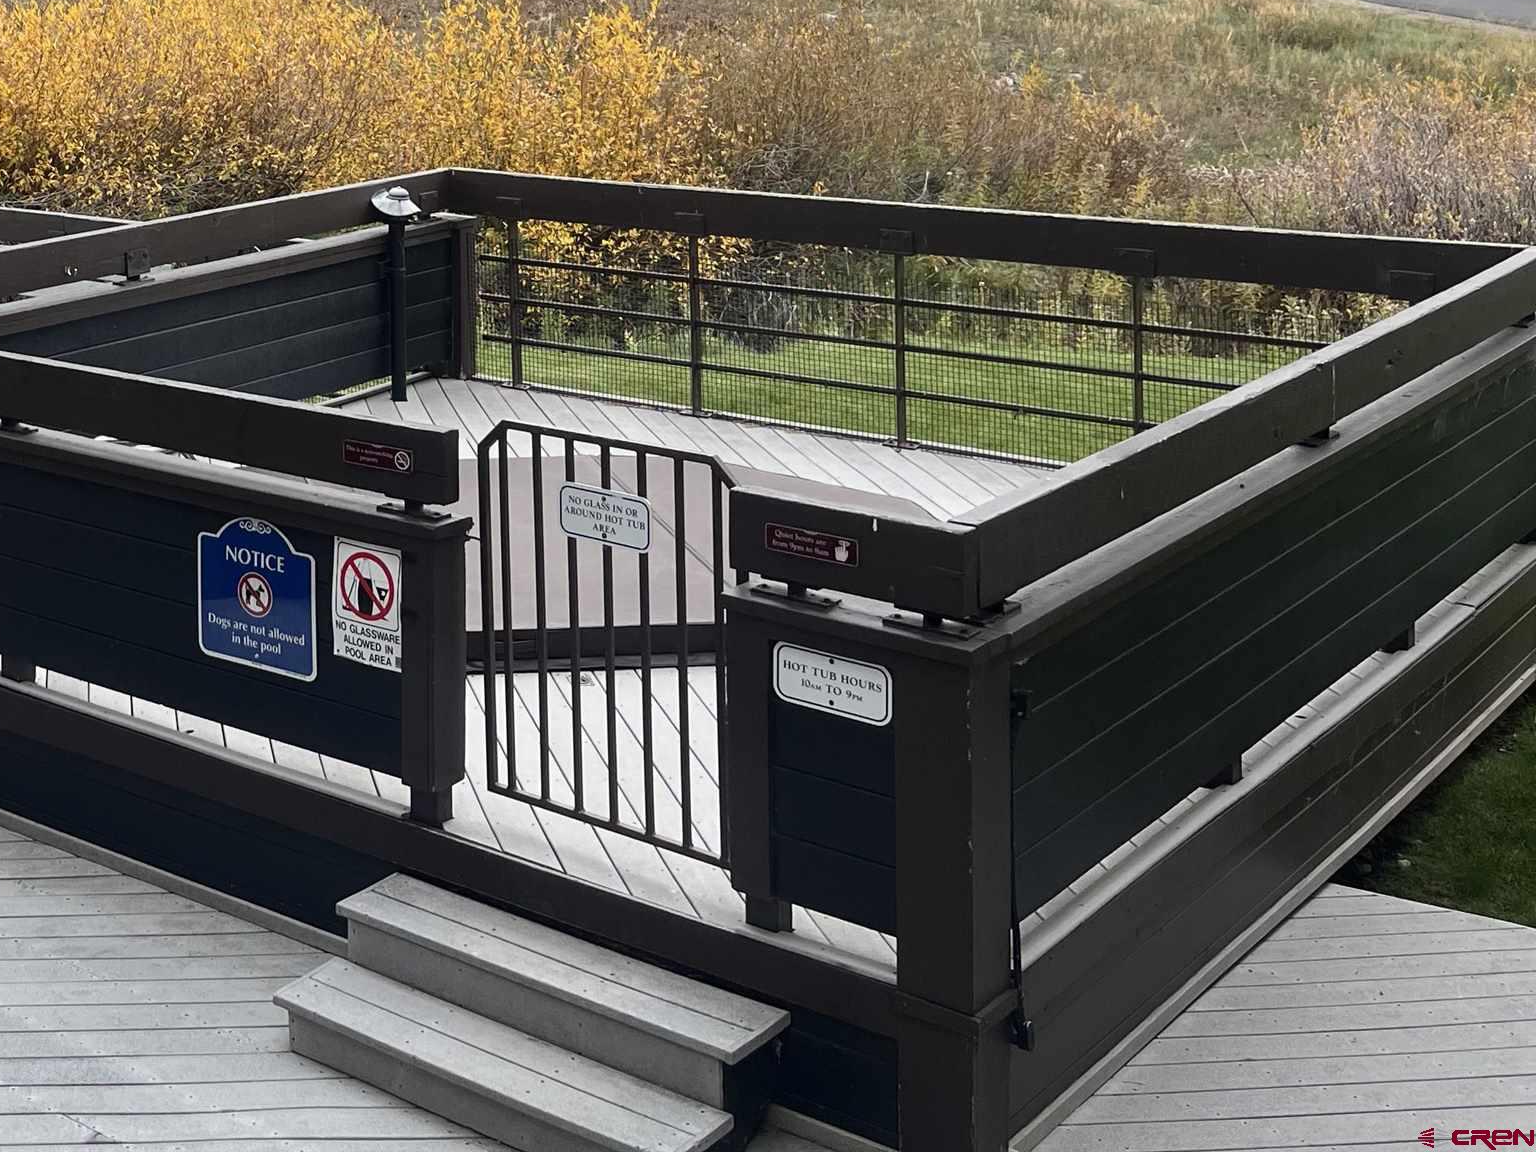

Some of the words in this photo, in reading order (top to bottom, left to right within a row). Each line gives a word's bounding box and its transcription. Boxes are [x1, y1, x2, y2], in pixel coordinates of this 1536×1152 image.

[564, 506, 602, 521] AROUND
[604, 514, 624, 526] HOT
[626, 519, 646, 530] TUB
[568, 495, 581, 505] NO
[584, 499, 610, 512] GLASS
[612, 504, 623, 513] IN
[625, 508, 638, 518] OR
[592, 523, 617, 535] AREA
[225, 545, 285, 573] NOTICE
[208, 612, 231, 630] Dogs
[233, 621, 248, 632] are
[250, 625, 265, 636] not
[268, 628, 305, 646] allowed
[335, 620, 347, 631] NO
[350, 624, 401, 645] GLASSWARE
[232, 632, 241, 644] in
[244, 636, 258, 648] the
[260, 643, 281, 655] pool
[344, 634, 382, 652] ALLOWED
[384, 645, 394, 655] IN
[345, 646, 366, 660] POOL
[369, 654, 392, 666] AREA
[783, 659, 809, 673] HOT
[811, 667, 837, 681] TUB
[840, 674, 882, 693] HOURS
[825, 684, 842, 696] TO
